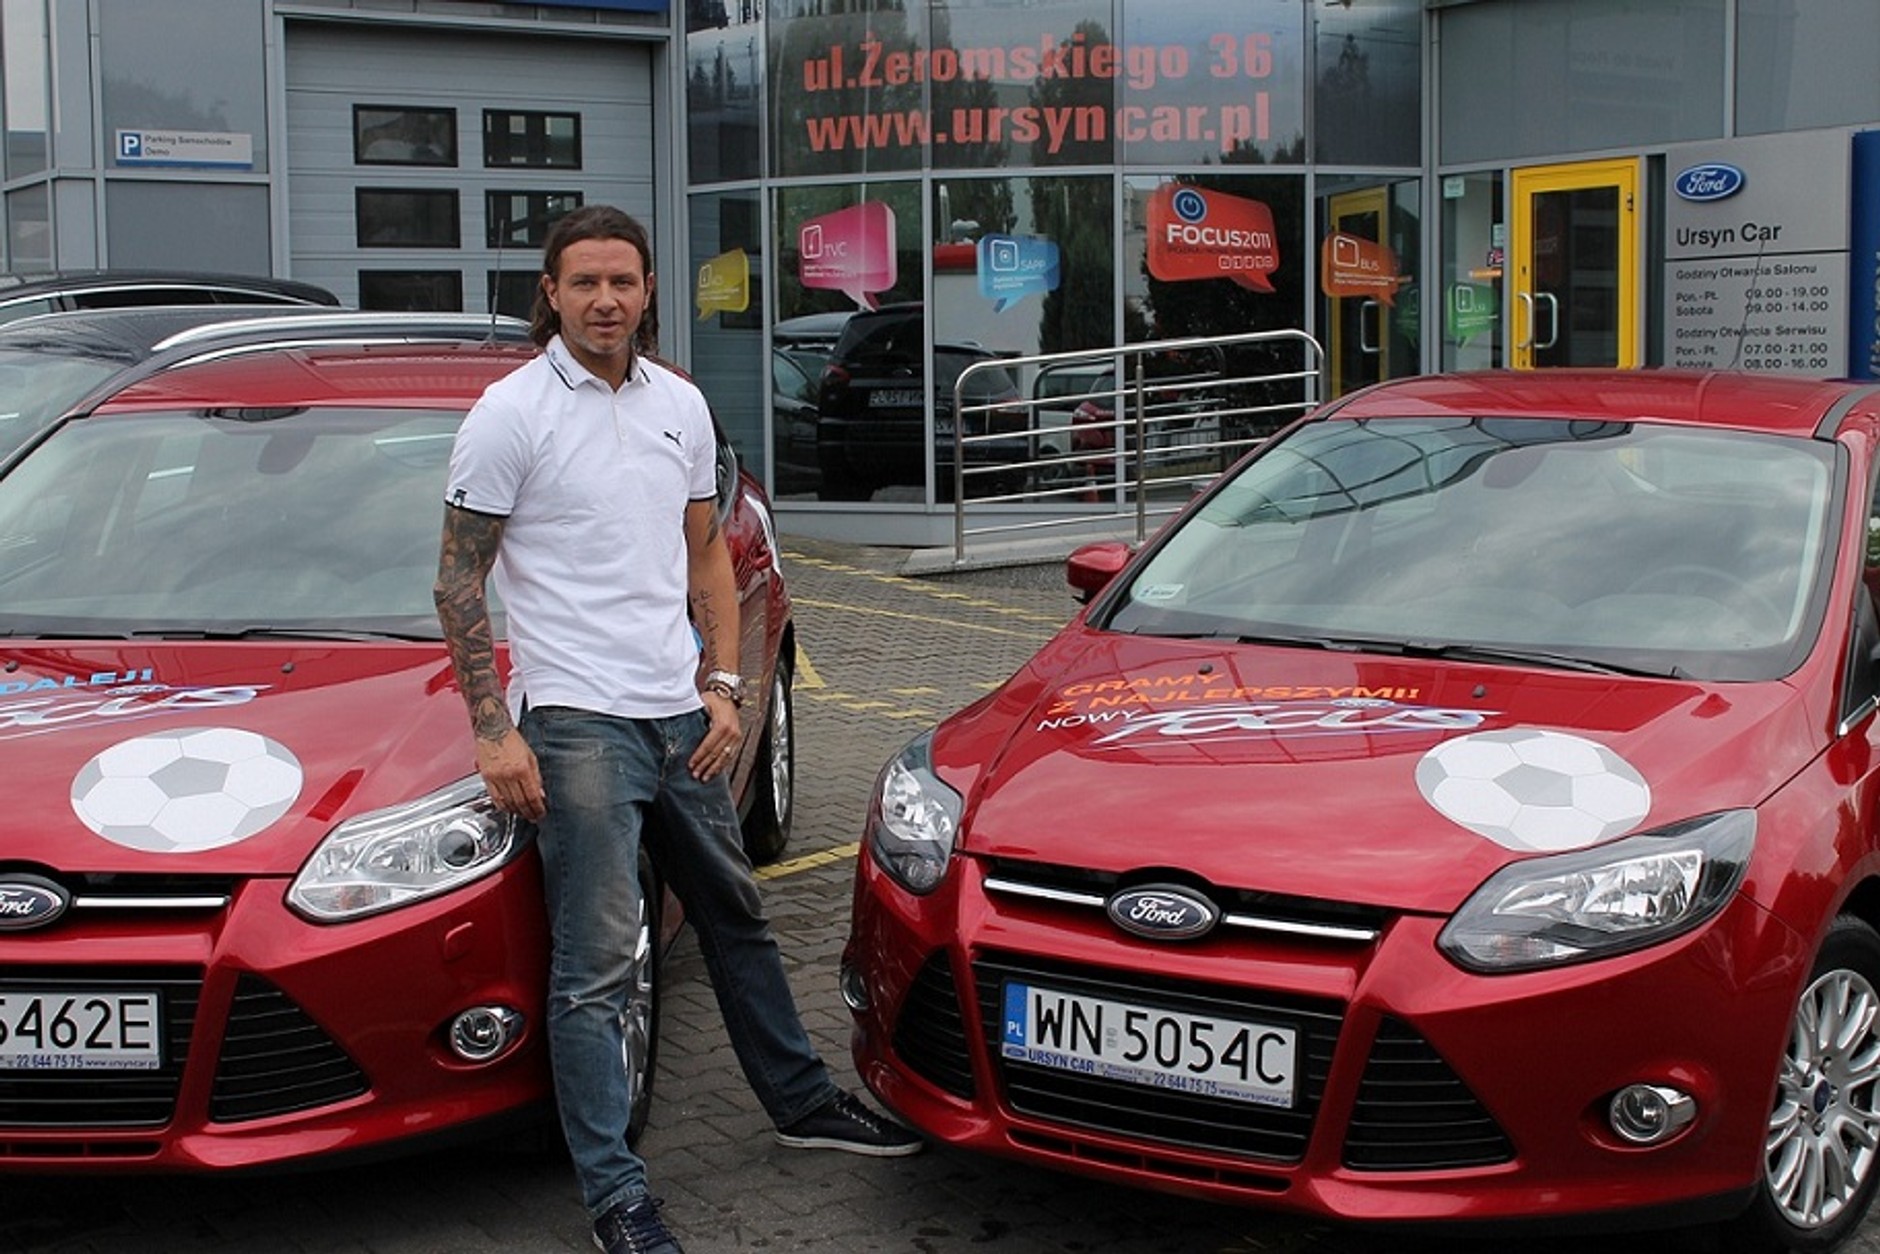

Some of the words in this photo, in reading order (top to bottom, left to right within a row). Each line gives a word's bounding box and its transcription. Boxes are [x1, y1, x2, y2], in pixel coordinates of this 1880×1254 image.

[803, 32, 1189, 92] ul.Żeromskiego
[1210, 33, 1272, 78] 36
[123, 135, 139, 154] P
[145, 135, 176, 145] Parking
[145, 147, 170, 155] Demo
[1676, 227, 1735, 248] Ursyn
[1740, 223, 1782, 242] Car
[1676, 270, 1718, 280] Godziny
[1721, 267, 1771, 278] Otwarcia
[1774, 264, 1817, 275] Salonu
[1745, 288, 1782, 299] 09.00
[1792, 286, 1829, 297] 19.00
[1676, 305, 1713, 316] Sobota
[1792, 301, 1829, 312] 14.00
[1676, 327, 1718, 338] Godziny
[1775, 324, 1826, 336] Serwisu
[1744, 343, 1782, 354] 07.00
[1789, 342, 1828, 354] 21.00
[1744, 358, 1782, 369] 08.00
[1064, 673, 1223, 696] GRAMY
[1048, 700, 1078, 715] Z
[1036, 709, 1142, 731] NOWY
[1130, 897, 1187, 925] Ford
[1007, 1020, 1023, 1037] PL
[1035, 994, 1102, 1055] WN
[1122, 1010, 1287, 1084] 5054C
[16, 1055, 28, 1068] 22
[55, 1055, 67, 1067] 75
[70, 1055, 83, 1067] 75
[1028, 1048, 1067, 1068] URSYN
[1070, 1058, 1094, 1072] CAR
[1154, 1072, 1164, 1085] 22
[1189, 1077, 1201, 1091] 75
[1205, 1080, 1217, 1095] 75
